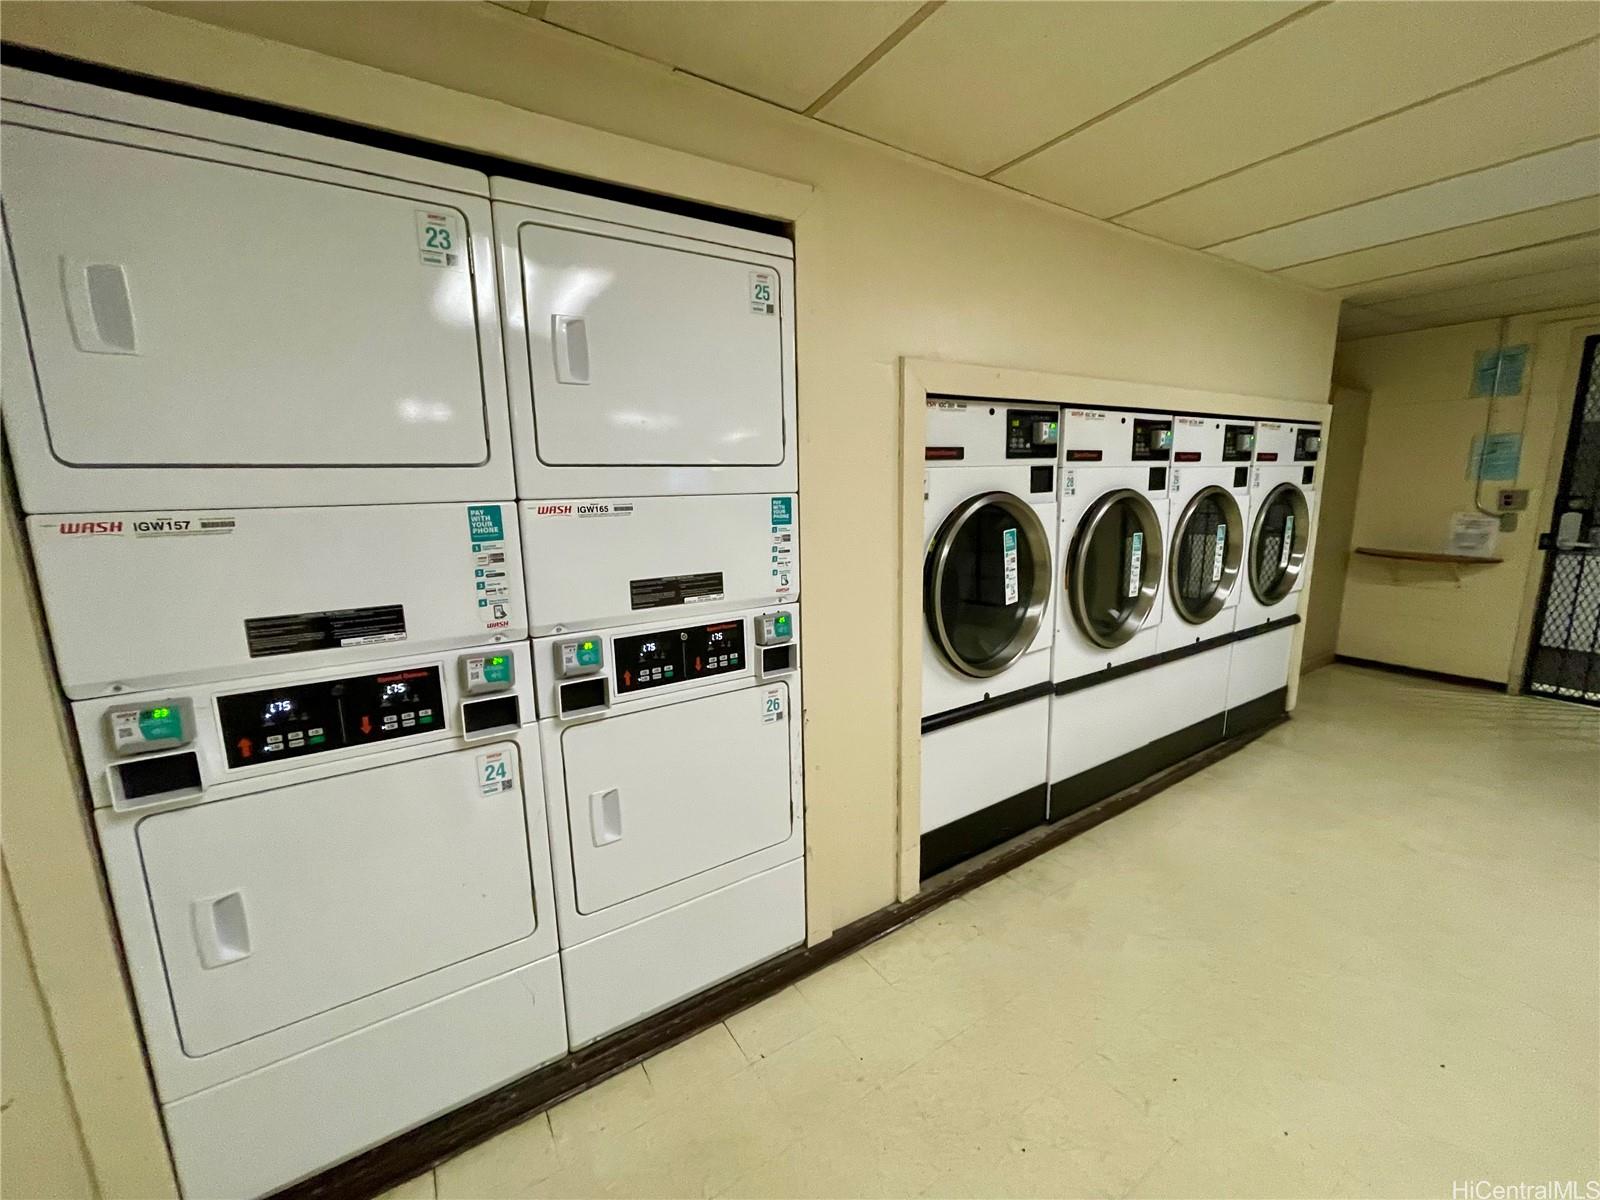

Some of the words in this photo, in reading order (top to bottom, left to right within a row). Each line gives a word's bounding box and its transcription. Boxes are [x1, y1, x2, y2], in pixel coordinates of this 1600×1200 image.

[425, 226, 452, 250] 23
[754, 283, 770, 301] 25
[537, 505, 572, 515] WASH
[577, 505, 609, 513] IGW165
[59, 521, 123, 534] WASH
[133, 520, 191, 532] IGW157
[472, 526, 499, 534] PHONE
[766, 697, 780, 712] 26
[153, 708, 169, 719] 23
[484, 761, 507, 782] 24
